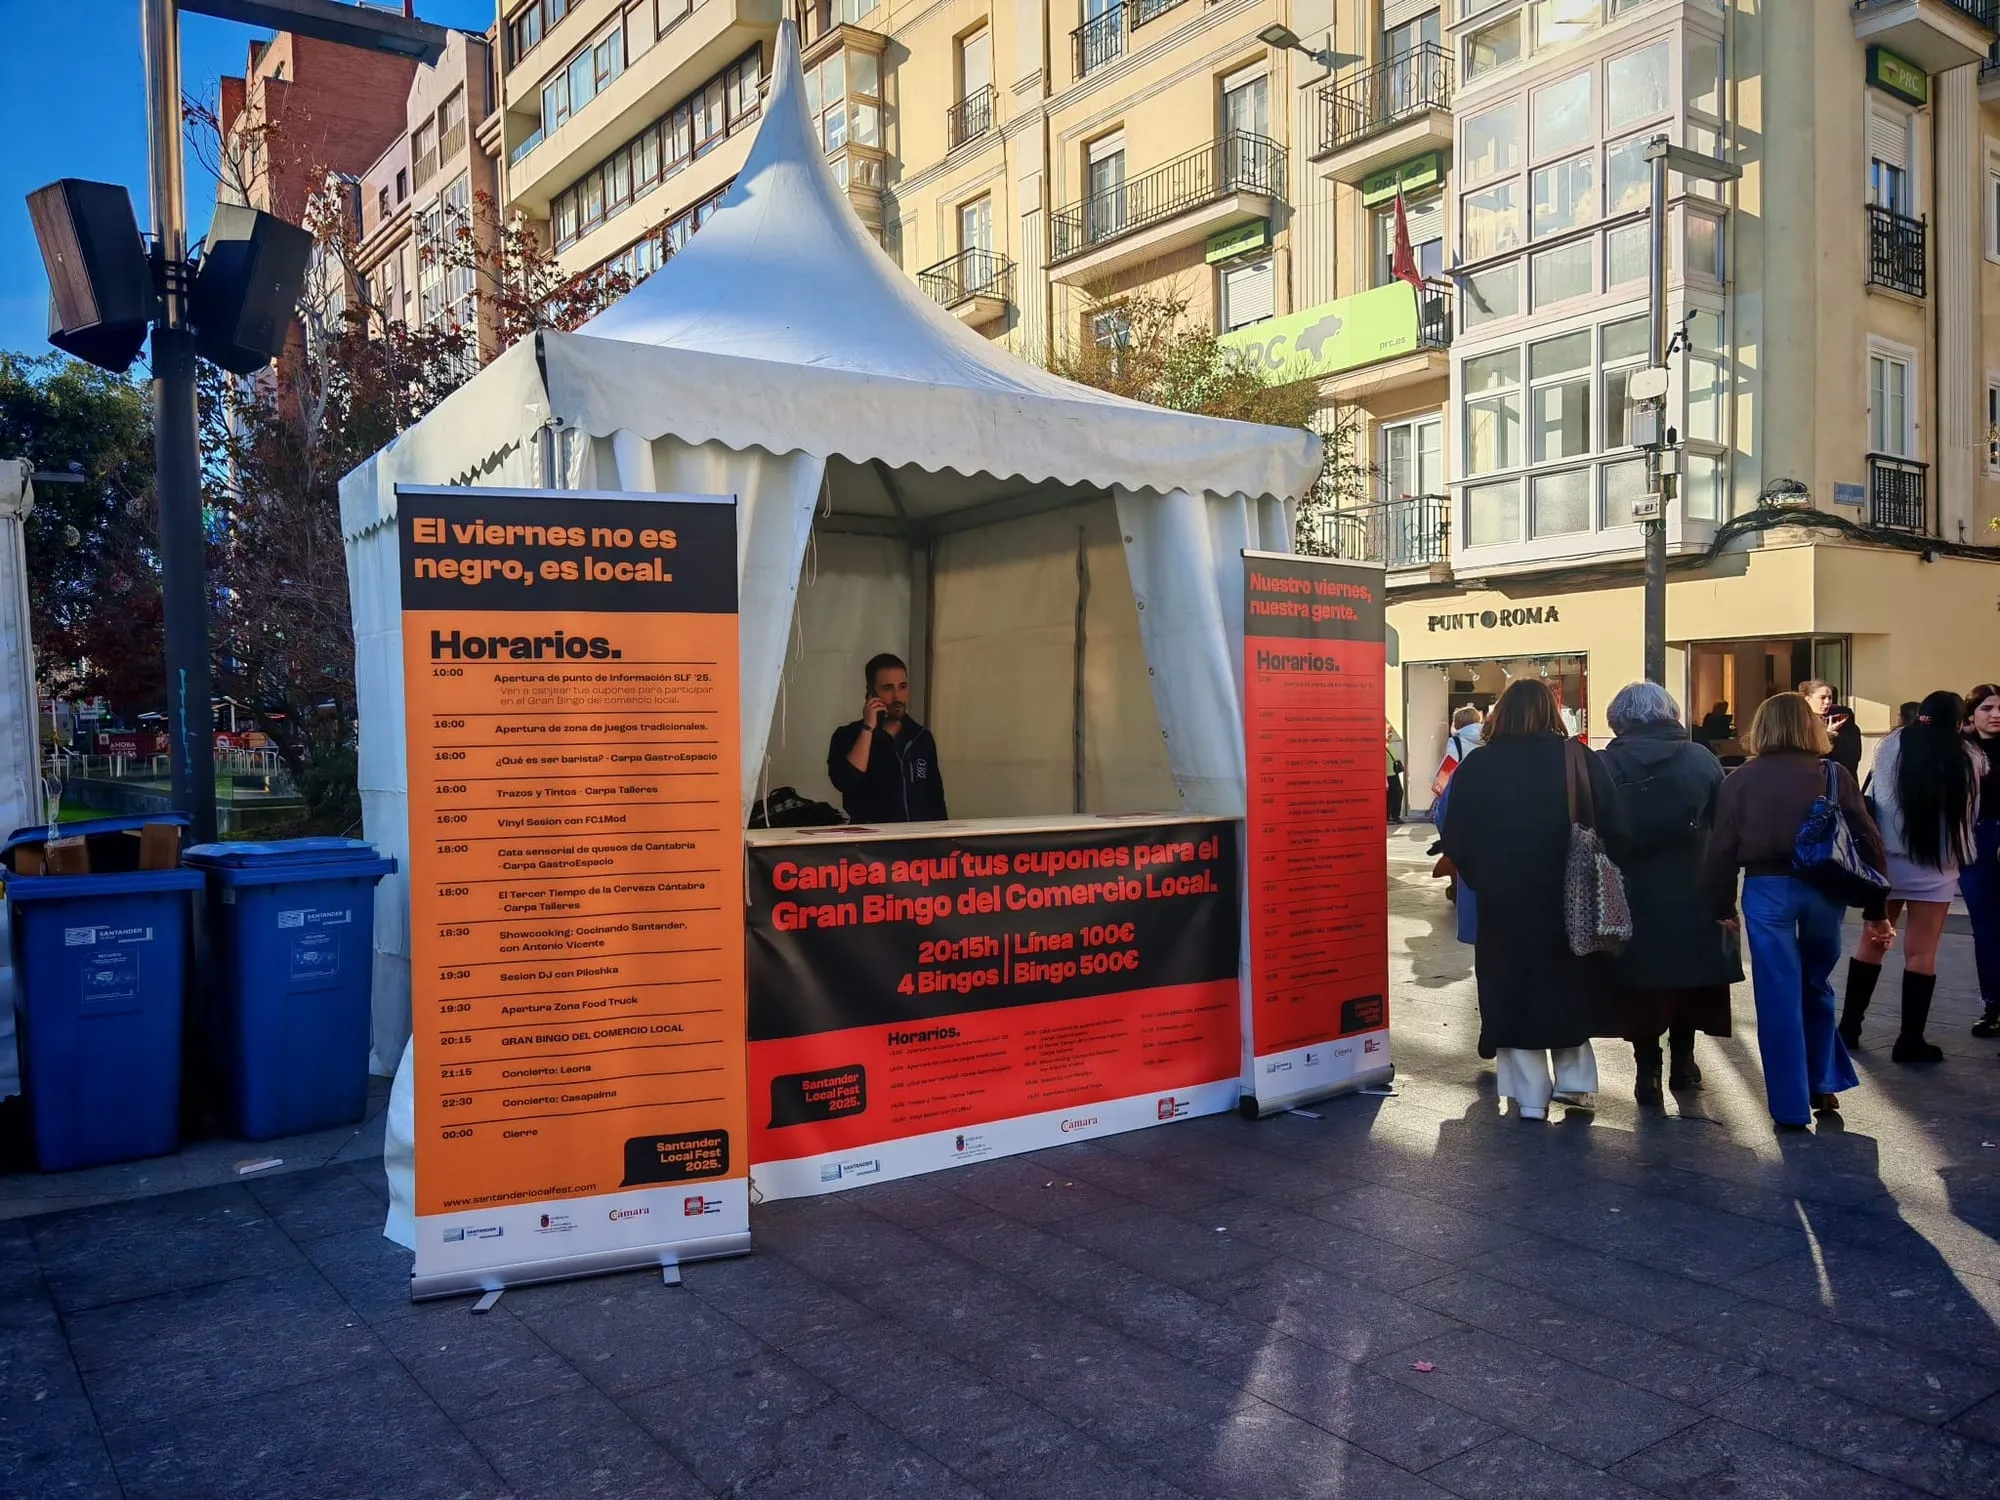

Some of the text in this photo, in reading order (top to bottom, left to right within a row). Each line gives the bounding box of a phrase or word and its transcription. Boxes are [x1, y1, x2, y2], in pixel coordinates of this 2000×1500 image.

[1900, 70, 1918, 91] PRC
[1374, 175, 1399, 192] PR
[1379, 336, 1406, 351] prc.es
[413, 518, 677, 549] El viernes no es
[414, 556, 672, 586] negro, es local.
[1250, 572, 1373, 603] Nuestro viernes,
[1250, 600, 1357, 622] nuestra gente.
[430, 630, 622, 660] Horarios.
[1257, 650, 1340, 672] Horarios.
[432, 669, 463, 677] 10:00
[494, 674, 544, 684] Apertura
[547, 674, 560, 682] de
[563, 675, 592, 684] punto
[595, 674, 608, 682] de
[674, 674, 692, 682] SLF
[533, 686, 570, 696] canjear
[574, 686, 589, 694] tus
[592, 687, 636, 695] cupones
[638, 687, 662, 695] para
[664, 686, 714, 694] participar
[434, 720, 465, 728] 16:00
[496, 724, 546, 734] Apertura
[549, 724, 561, 732] de
[564, 724, 588, 732] zona
[604, 724, 637, 733] juegos
[640, 723, 708, 731] tradicionales.
[435, 752, 466, 760] 16:00
[496, 756, 523, 767] ¿Qué
[561, 754, 603, 763] barista?
[610, 754, 642, 763] Carpa
[644, 752, 717, 762] GastroEspacio
[436, 785, 466, 793] 16:00
[497, 789, 533, 798] Trazos
[536, 790, 542, 798] y
[545, 787, 576, 796] Tintos
[585, 787, 616, 796] Carpa
[619, 785, 658, 794] Talleres
[437, 815, 467, 823] 16:00
[498, 818, 524, 828] Vinyl
[437, 844, 468, 853] 18:00
[498, 840, 695, 856] Cata sensorial de quesos de Cantabria
[503, 861, 536, 870] Carpa
[539, 856, 613, 869] GastroEspacio
[772, 836, 1218, 892] Canjea aquí tus cupones para el
[438, 887, 469, 896] 18:00
[499, 891, 508, 899] El
[510, 889, 546, 898] Tercer
[549, 887, 586, 898] Tiempo
[588, 886, 600, 894] de
[603, 885, 612, 893] la
[614, 883, 655, 893] Cerveza
[504, 903, 537, 913] Carpa
[540, 902, 580, 911] Talleres
[771, 870, 1218, 932] Gran Bingo del Comercio Local.
[439, 928, 470, 937] 18:30
[500, 928, 574, 939] Showcooking:
[576, 924, 629, 935] Cocinando
[500, 939, 605, 953] con Antonio Vicente
[918, 922, 1135, 966] 20:15h Línea 100€
[440, 970, 470, 980] 19:30
[538, 971, 552, 980] DJ
[555, 970, 574, 978] con
[576, 966, 619, 976] Piloshka
[897, 949, 1139, 995] 4 Bingos Bingo 500€
[440, 1004, 471, 1013] 19:30
[502, 996, 638, 1015] Apertura Zona Food Truck
[440, 1035, 471, 1046] 20:15
[501, 1023, 684, 1046] GRAN BINGO DEL COMERCIO LOCAL
[888, 1026, 960, 1047] Horarios.
[441, 1068, 472, 1078] 21:15
[502, 1064, 592, 1079] Concierto: Leona
[802, 1073, 859, 1091] Santander
[502, 1089, 617, 1108] Concierto: Casapalma
[805, 1085, 860, 1103] Local Fest
[441, 1097, 473, 1107] 22:30
[829, 1098, 860, 1111] 2025.
[1060, 1117, 1098, 1132] Cámara
[442, 1129, 473, 1140] 00:00
[503, 1128, 538, 1139] Cierre
[656, 1137, 721, 1152] Santander
[661, 1147, 721, 1163] Local Fest
[685, 1160, 721, 1172] 2025.
[843, 1160, 873, 1171] SANTANDER
[443, 1182, 596, 1208] www.santanderlocalfest.com
[609, 1206, 650, 1221] Cámara
